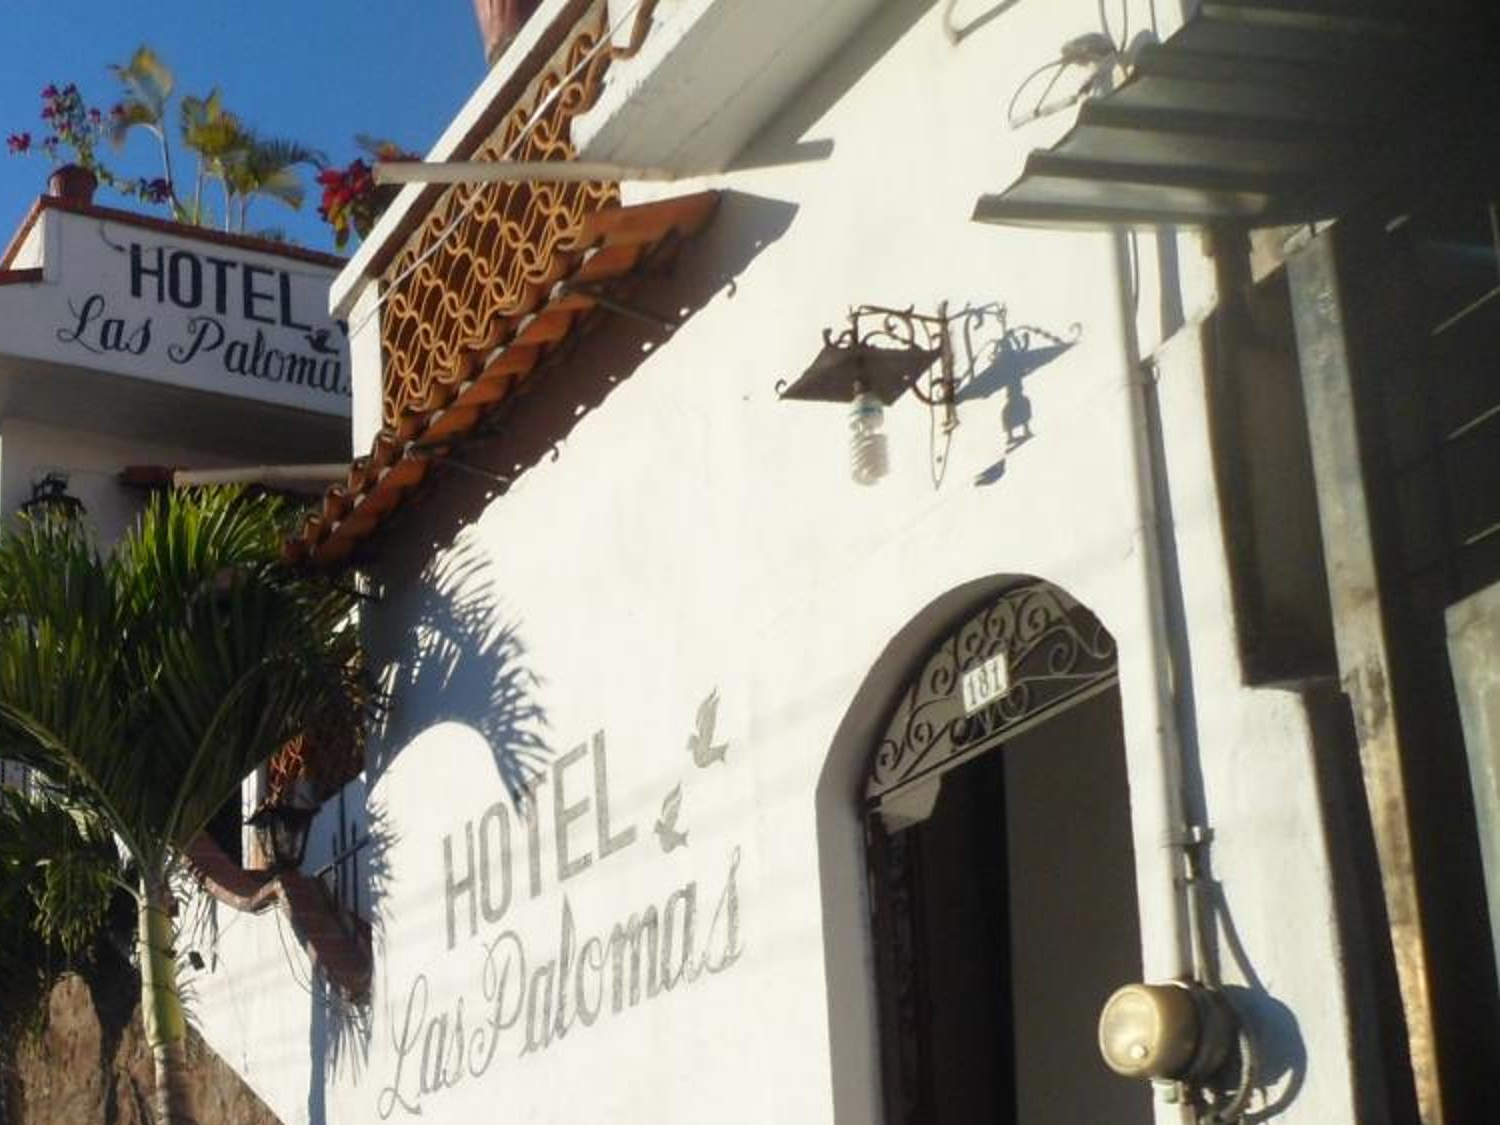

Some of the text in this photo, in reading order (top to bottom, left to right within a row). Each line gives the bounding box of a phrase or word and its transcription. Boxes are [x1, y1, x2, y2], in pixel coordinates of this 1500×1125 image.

[56, 293, 152, 357] Las
[129, 242, 313, 334] HOTEL
[967, 659, 1001, 706] 181
[442, 728, 637, 951] HOTEL
[377, 844, 746, 1121] Las Palomas
